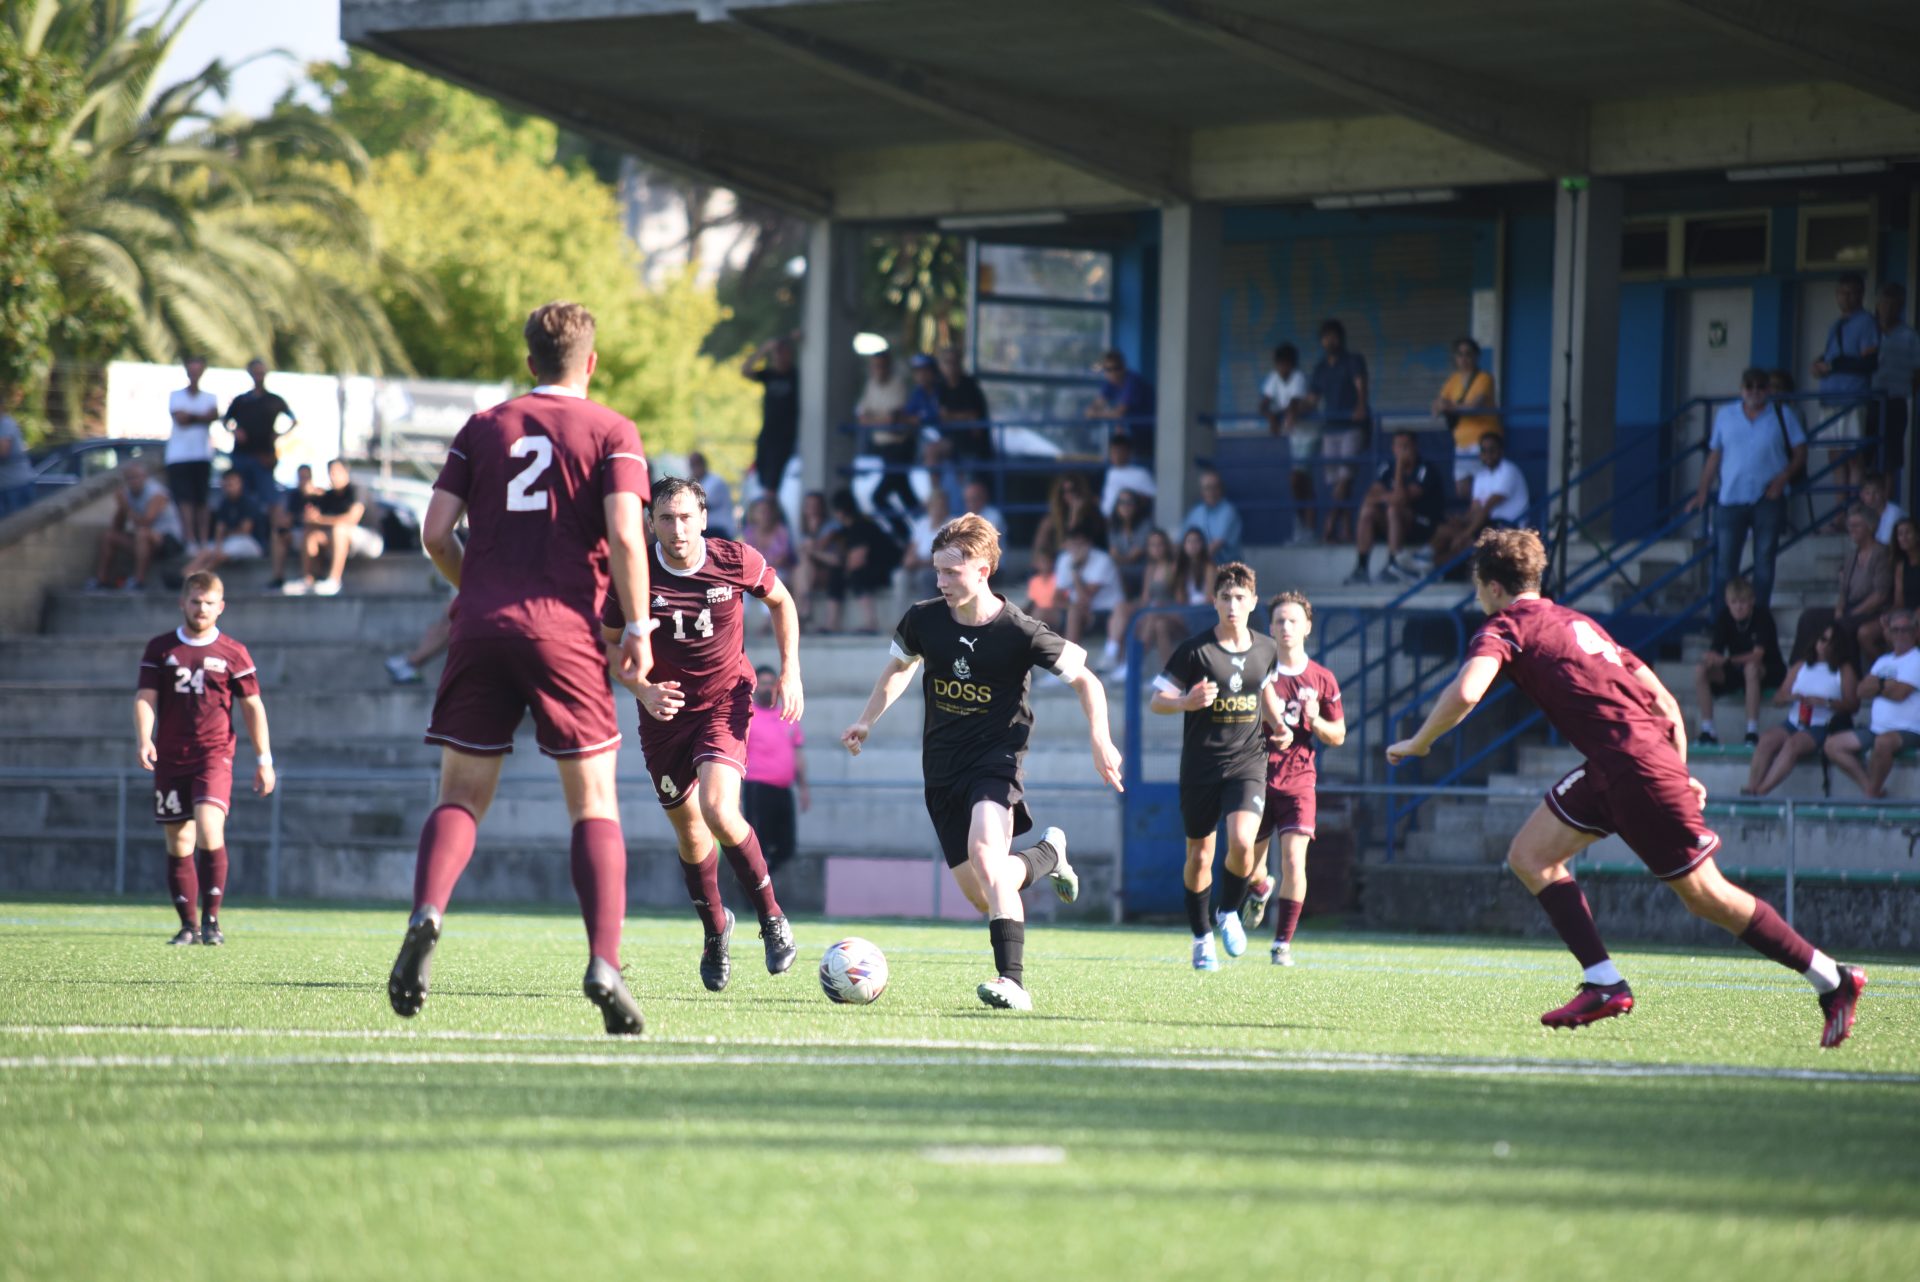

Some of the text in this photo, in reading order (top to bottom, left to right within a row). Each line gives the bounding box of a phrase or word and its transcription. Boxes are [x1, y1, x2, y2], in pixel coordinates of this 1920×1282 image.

[506, 435, 553, 512] 2
[672, 608, 714, 640] 14
[1572, 620, 1623, 668] 4
[174, 666, 205, 695] 24
[934, 678, 992, 703] DOSS
[1213, 694, 1257, 712] DOSS
[155, 789, 183, 815] 24
